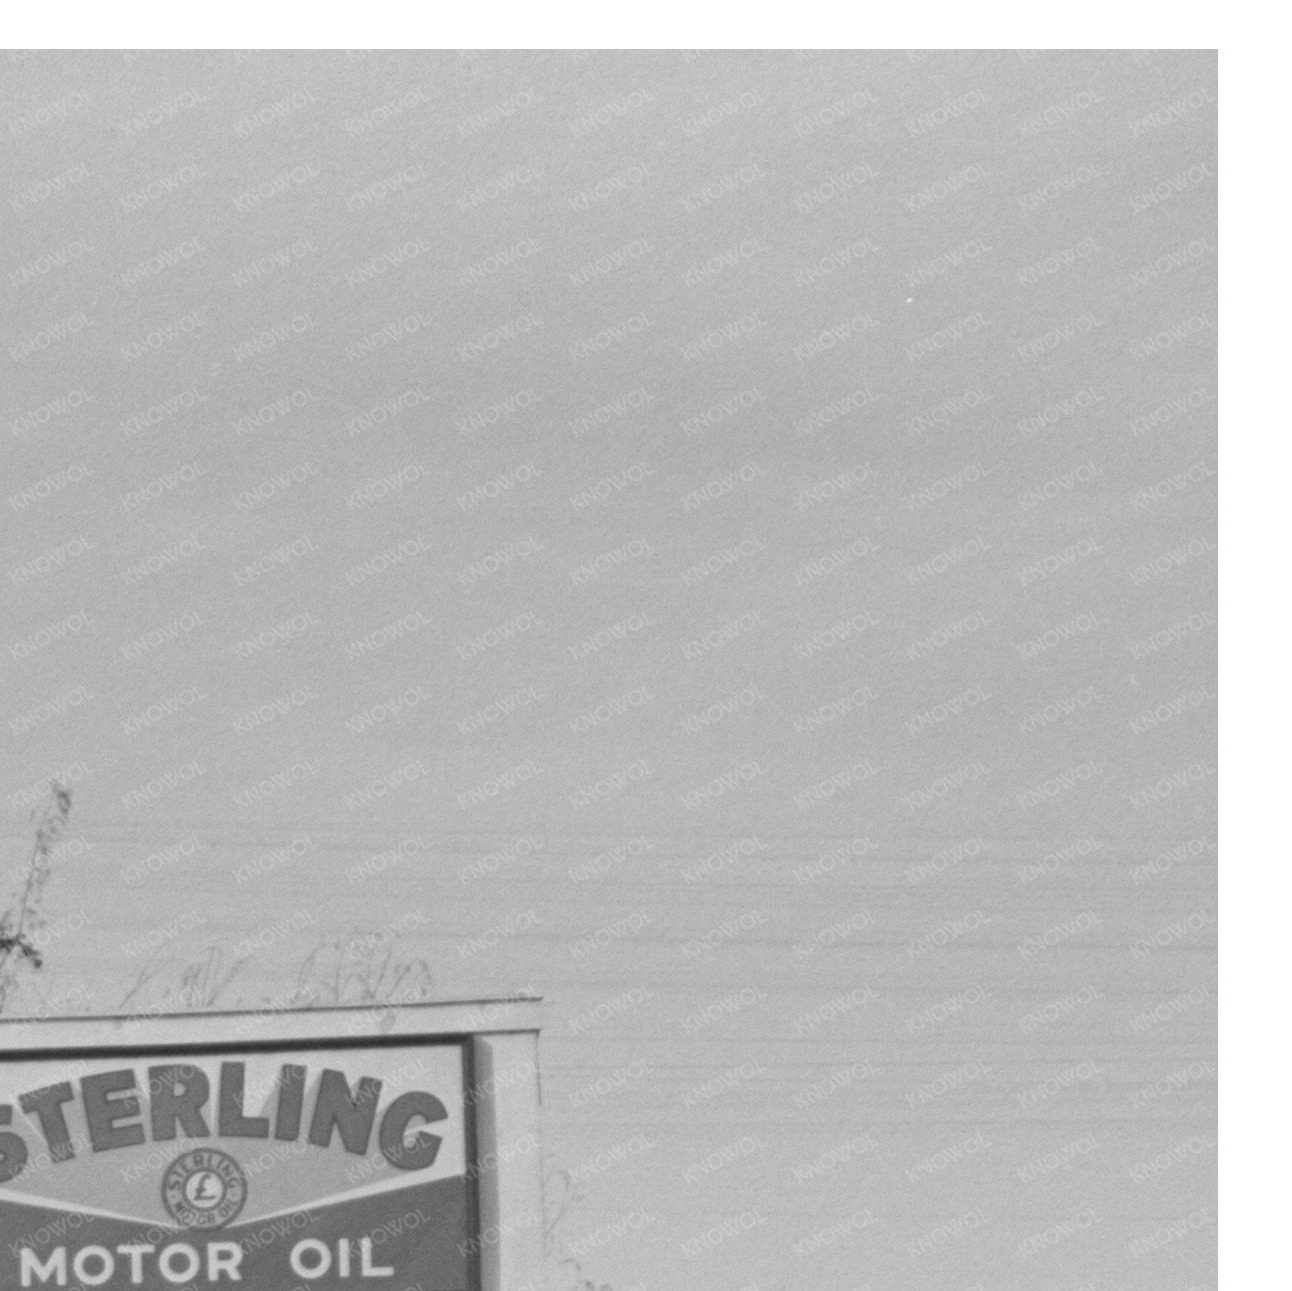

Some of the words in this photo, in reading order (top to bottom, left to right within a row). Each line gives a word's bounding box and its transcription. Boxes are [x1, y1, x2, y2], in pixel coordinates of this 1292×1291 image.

[166, 1151, 242, 1193] STERLING
[173, 1199, 218, 1227] MOTOR
[218, 1194, 240, 1221] OIL
[20, 1241, 243, 1288] MOTOR
[289, 1238, 396, 1280] OIL
